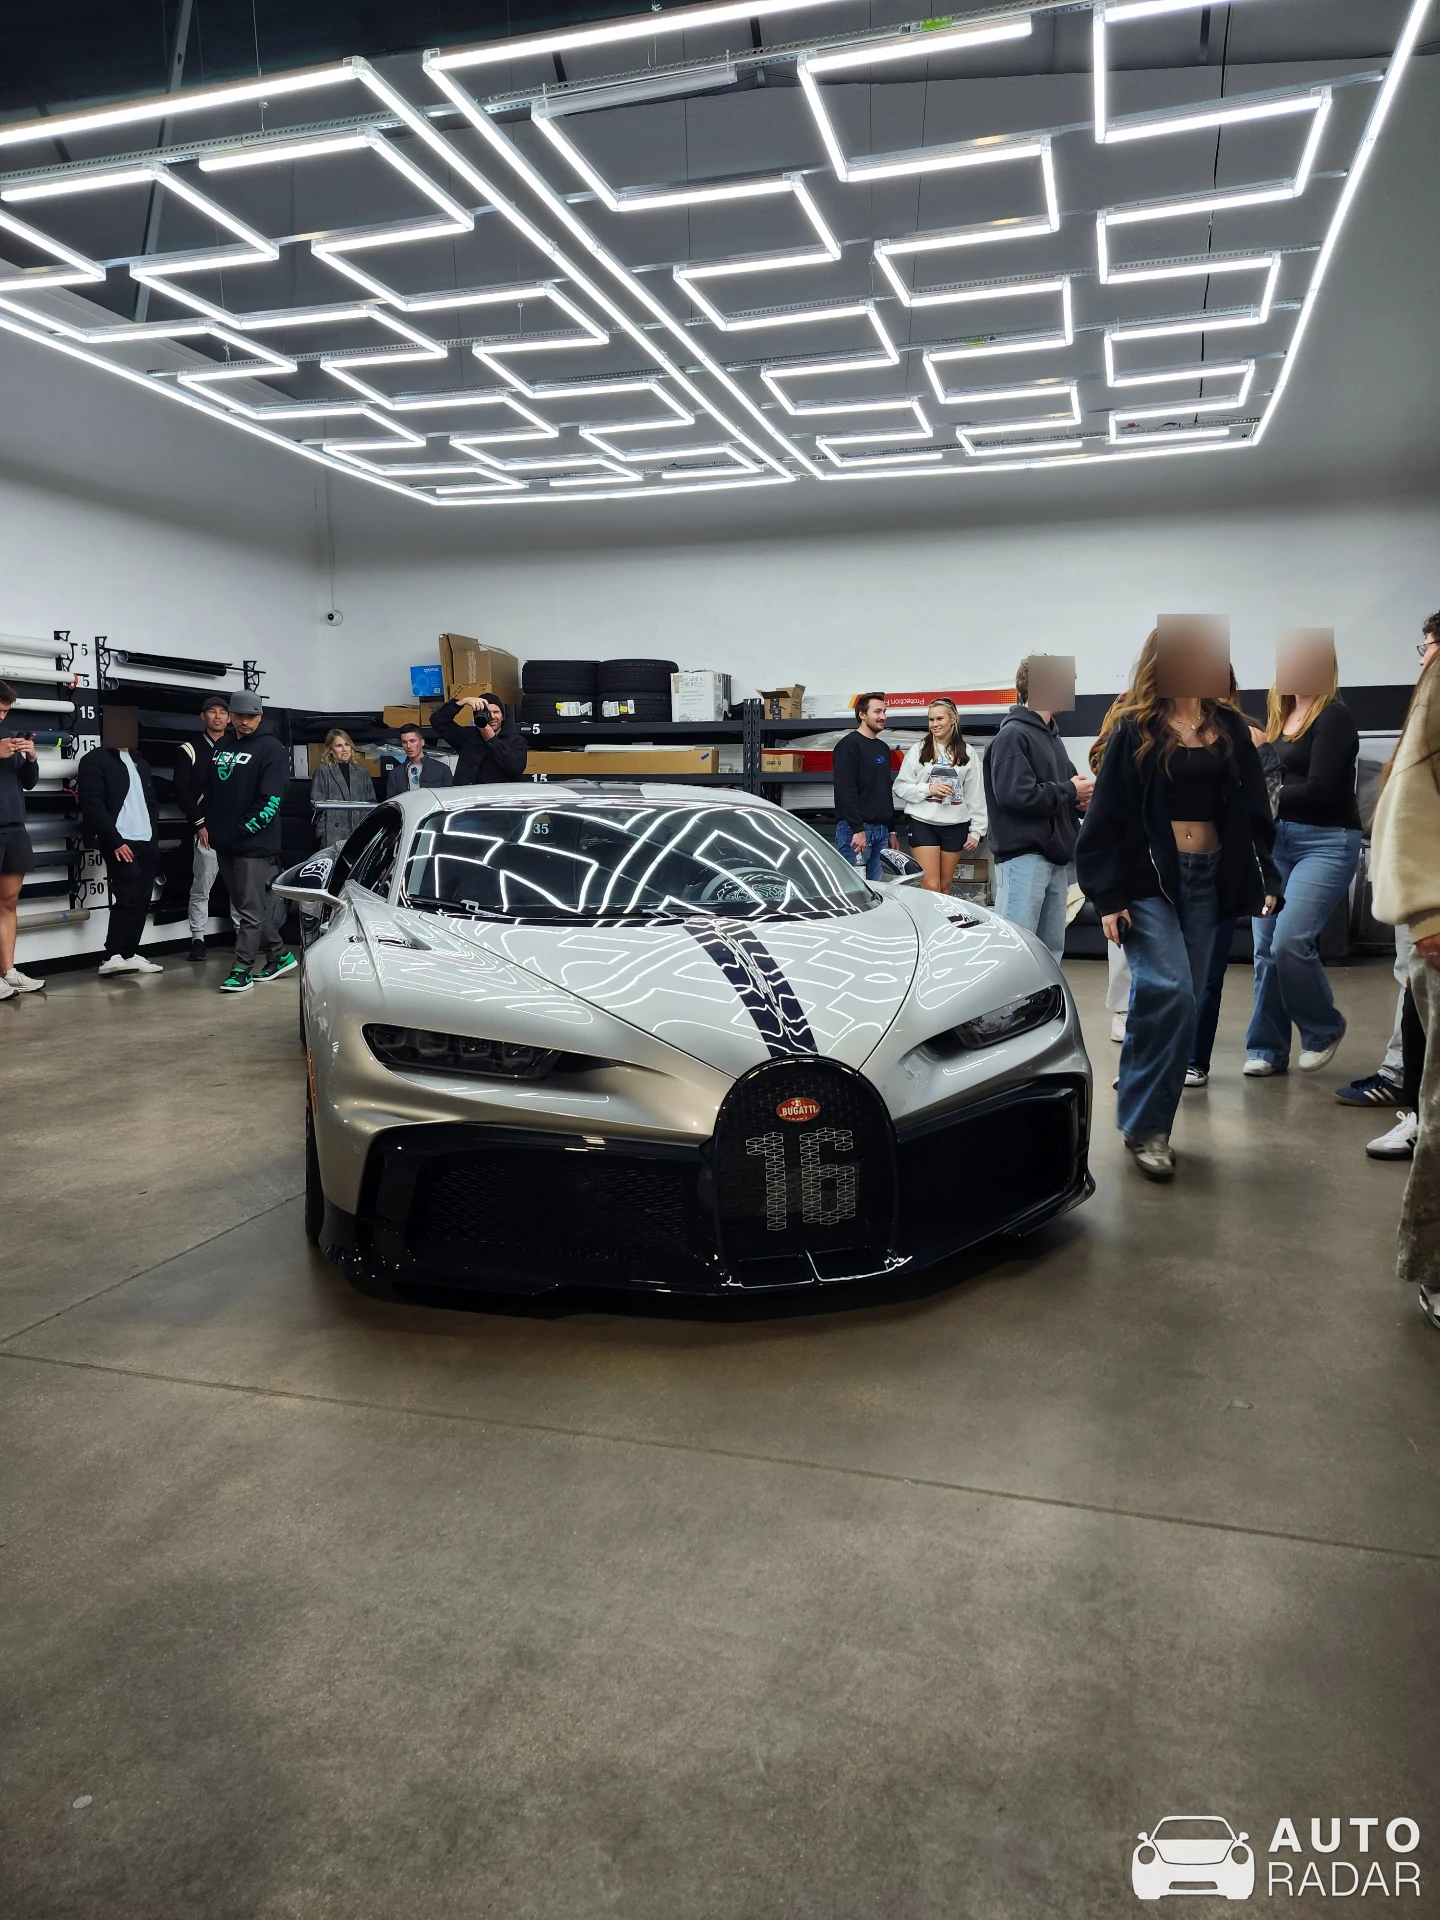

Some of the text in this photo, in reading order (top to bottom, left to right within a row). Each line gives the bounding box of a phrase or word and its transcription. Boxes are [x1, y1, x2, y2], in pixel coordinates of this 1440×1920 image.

[81, 644, 88, 656] 5
[83, 676, 90, 687] 5
[80, 705, 96, 719] 15
[82, 740, 96, 752] 15
[532, 774, 548, 783] 15
[533, 824, 549, 835] 35
[88, 854, 103, 867] 50
[90, 881, 105, 895] 50
[782, 1105, 816, 1116] BUGATTI
[746, 1127, 855, 1231] 16
